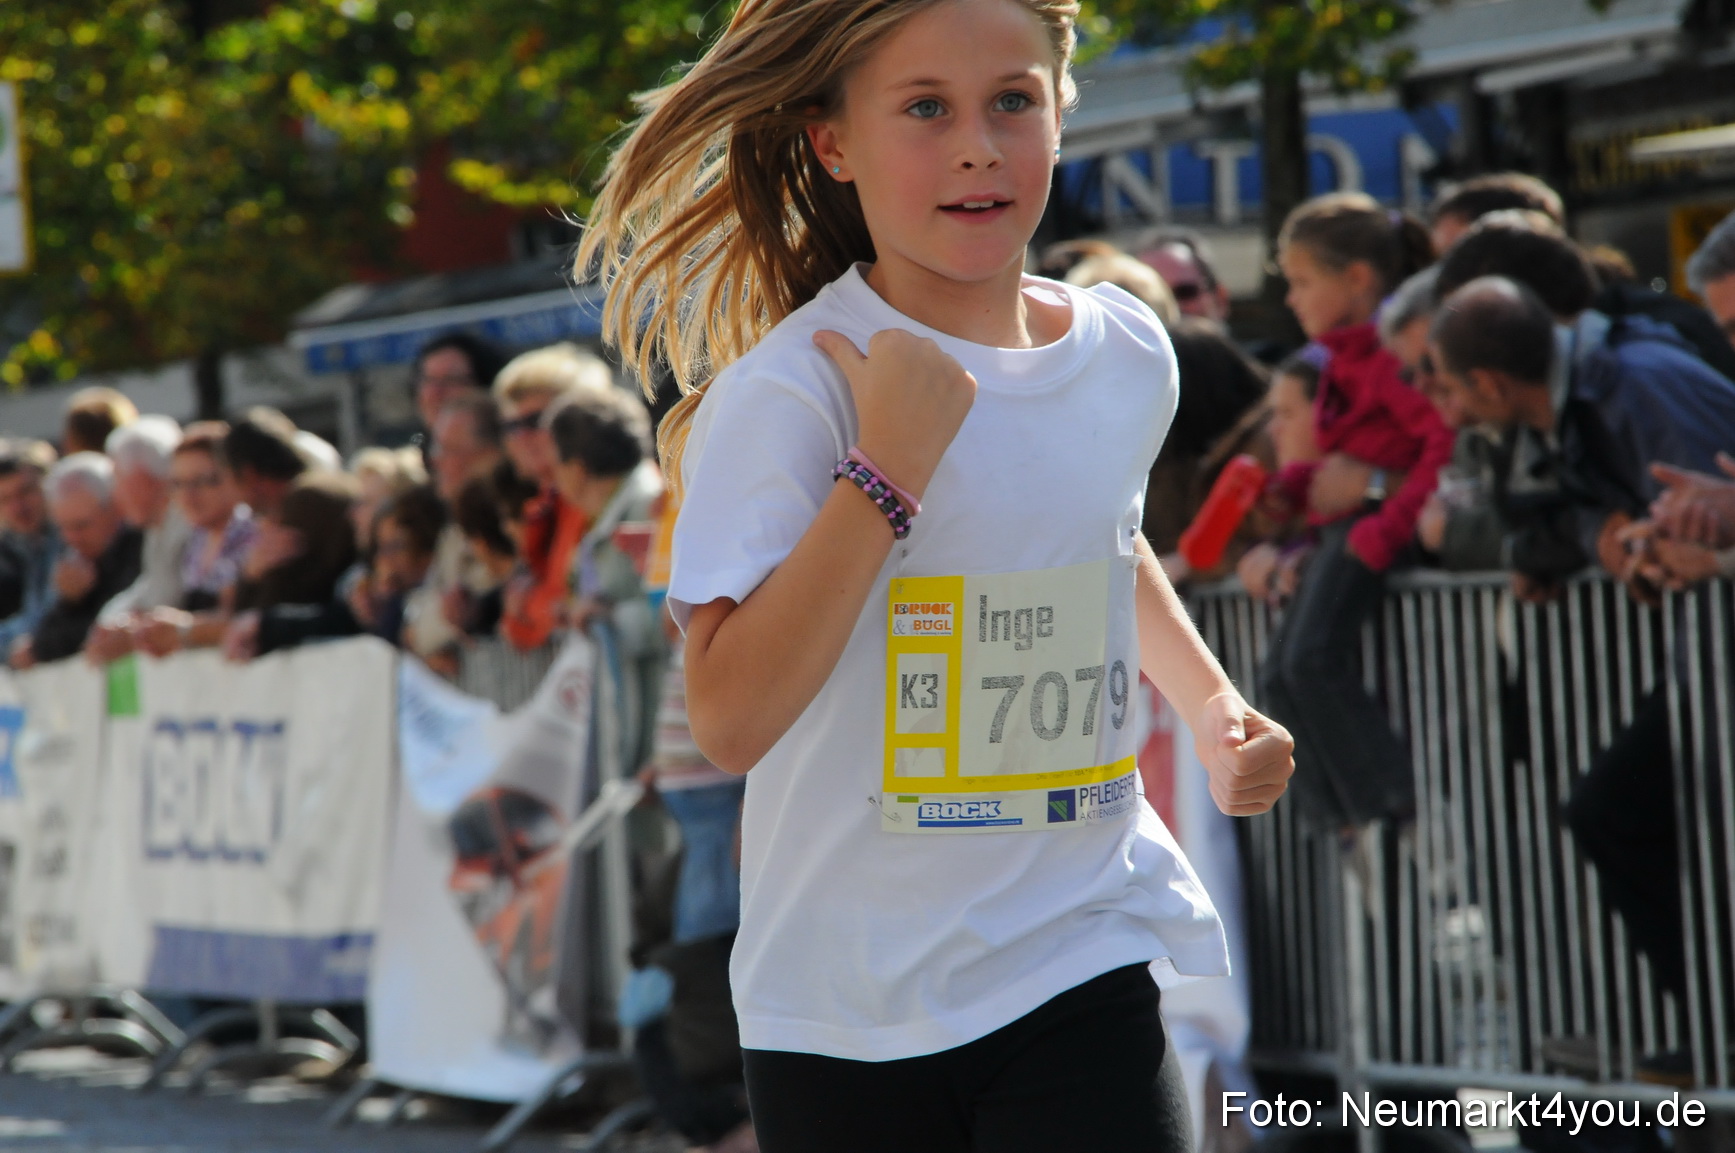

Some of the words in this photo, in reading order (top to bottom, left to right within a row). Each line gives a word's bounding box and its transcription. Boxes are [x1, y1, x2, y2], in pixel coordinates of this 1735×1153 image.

[978, 594, 1055, 651] Inge
[900, 673, 939, 709] K3
[981, 659, 1129, 744] 7079
[918, 801, 1002, 819] BOCK
